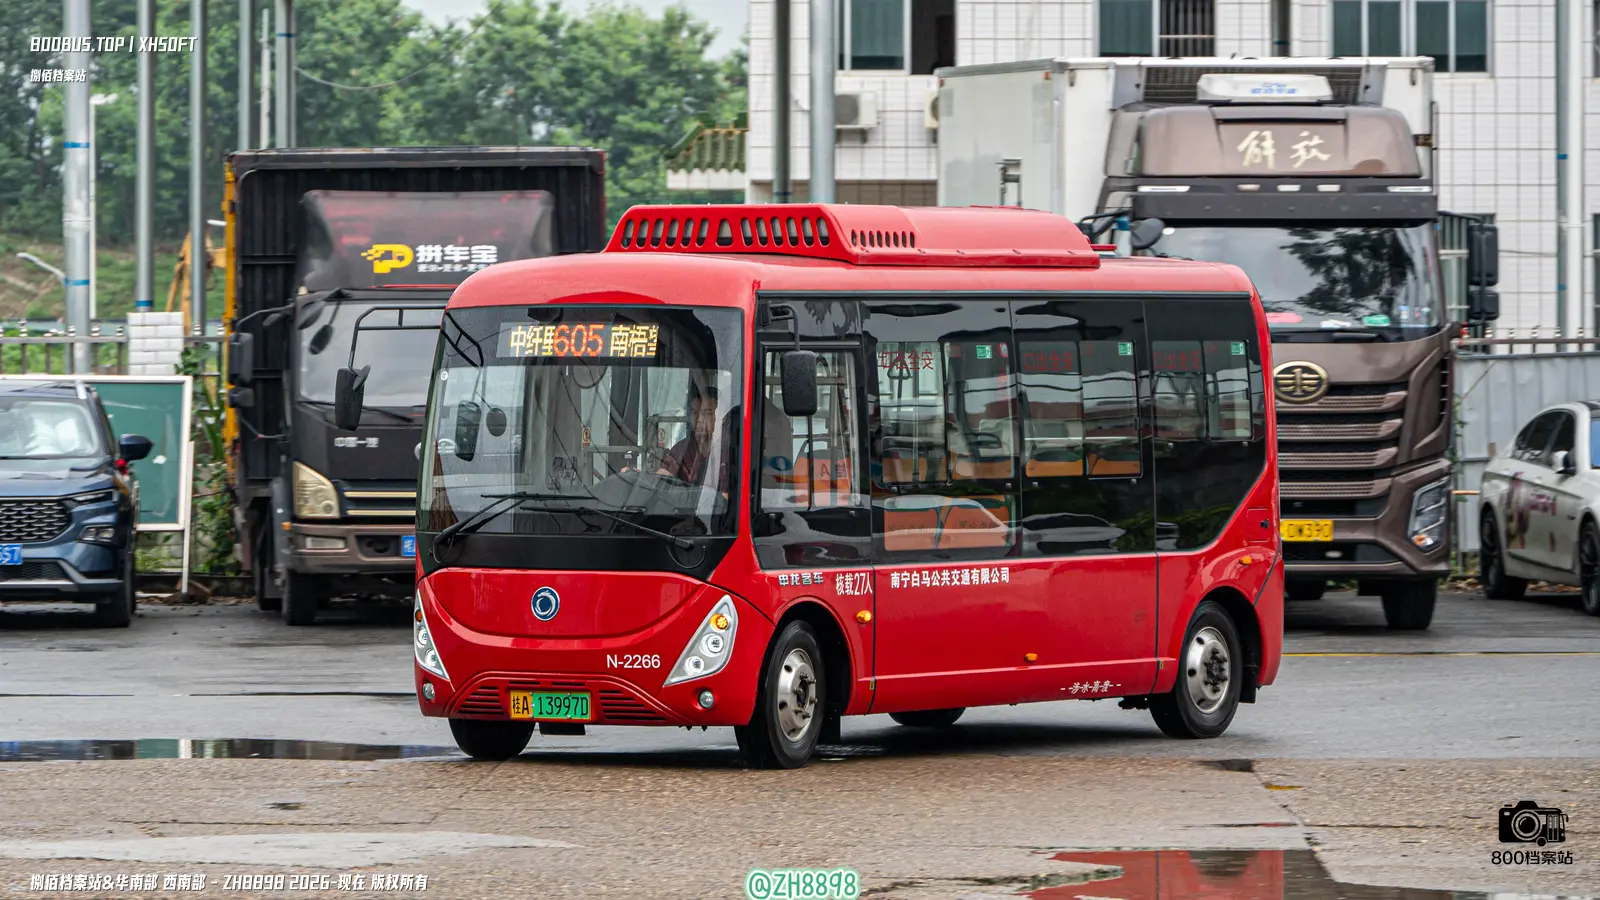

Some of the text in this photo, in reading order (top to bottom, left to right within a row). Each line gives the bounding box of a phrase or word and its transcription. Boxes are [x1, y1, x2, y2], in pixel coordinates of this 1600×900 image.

[416, 244, 498, 263] 拼车宝
[553, 323, 605, 357] 605
[777, 572, 824, 587] 申龙客车
[836, 572, 873, 596] 核载27人
[890, 567, 1010, 588] 南宁白马公共交通有限公司
[606, 654, 661, 669] N-2266
